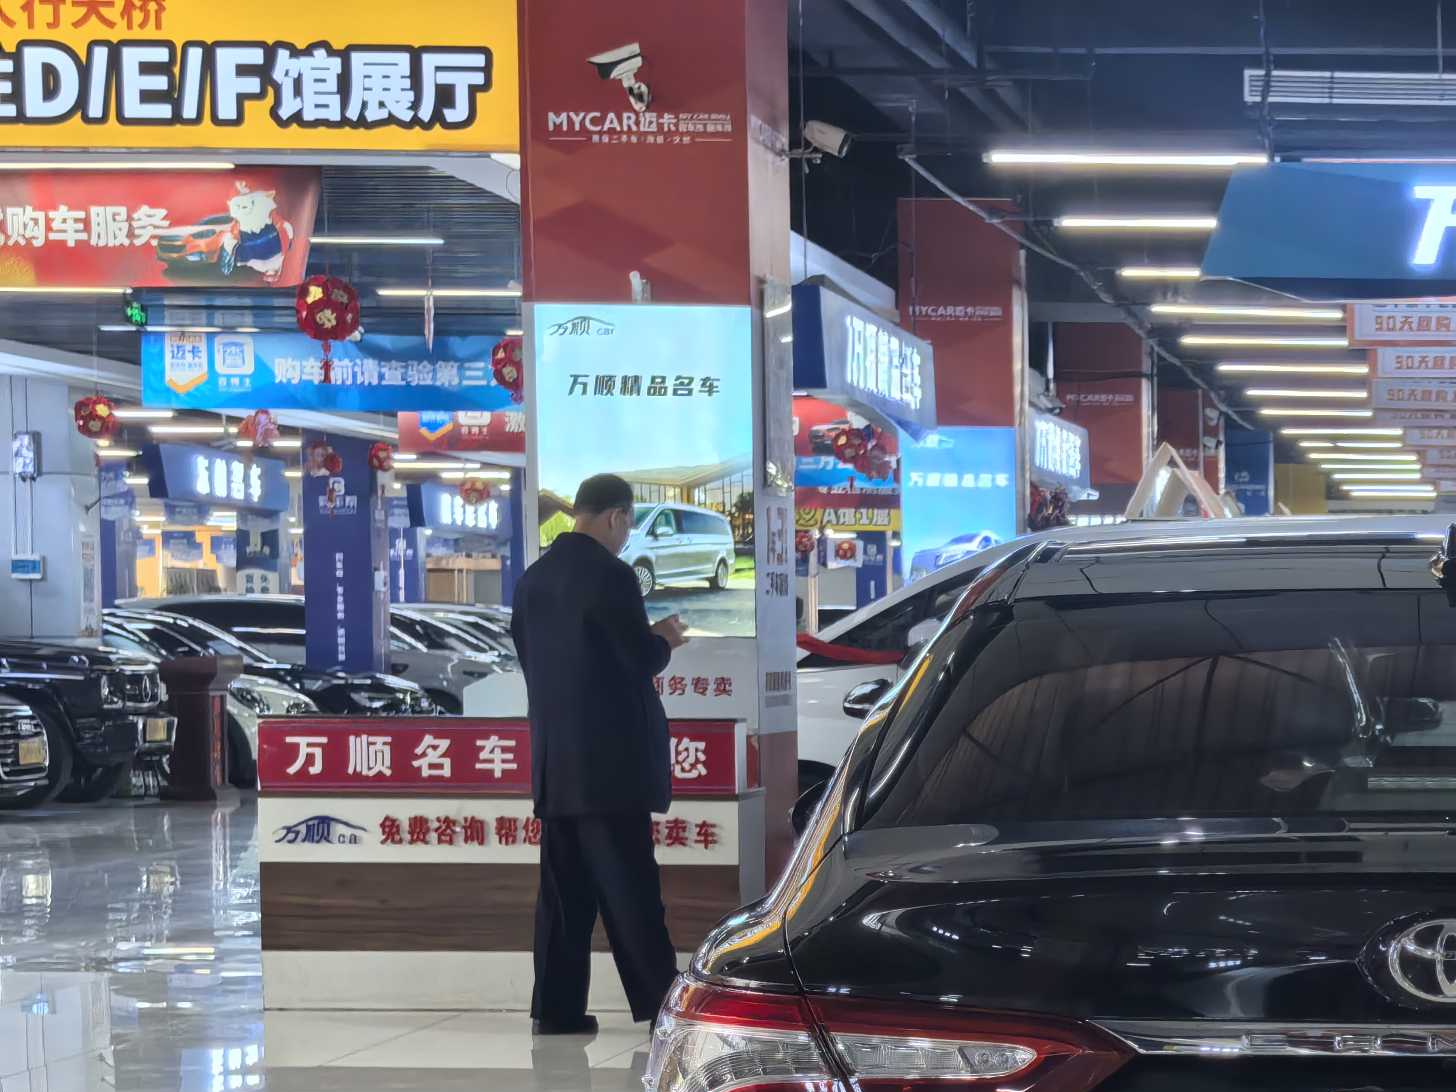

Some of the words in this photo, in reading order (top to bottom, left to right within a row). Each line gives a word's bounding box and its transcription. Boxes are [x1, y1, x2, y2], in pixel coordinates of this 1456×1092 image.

[0, 45, 487, 123] D/E/F馆展厅
[0, 205, 171, 248] 购车服务
[273, 356, 502, 387] 购车前请查验第三
[568, 373, 721, 397] 万顺精品名车
[285, 734, 519, 777] 万顺名车
[670, 737, 708, 779] 您
